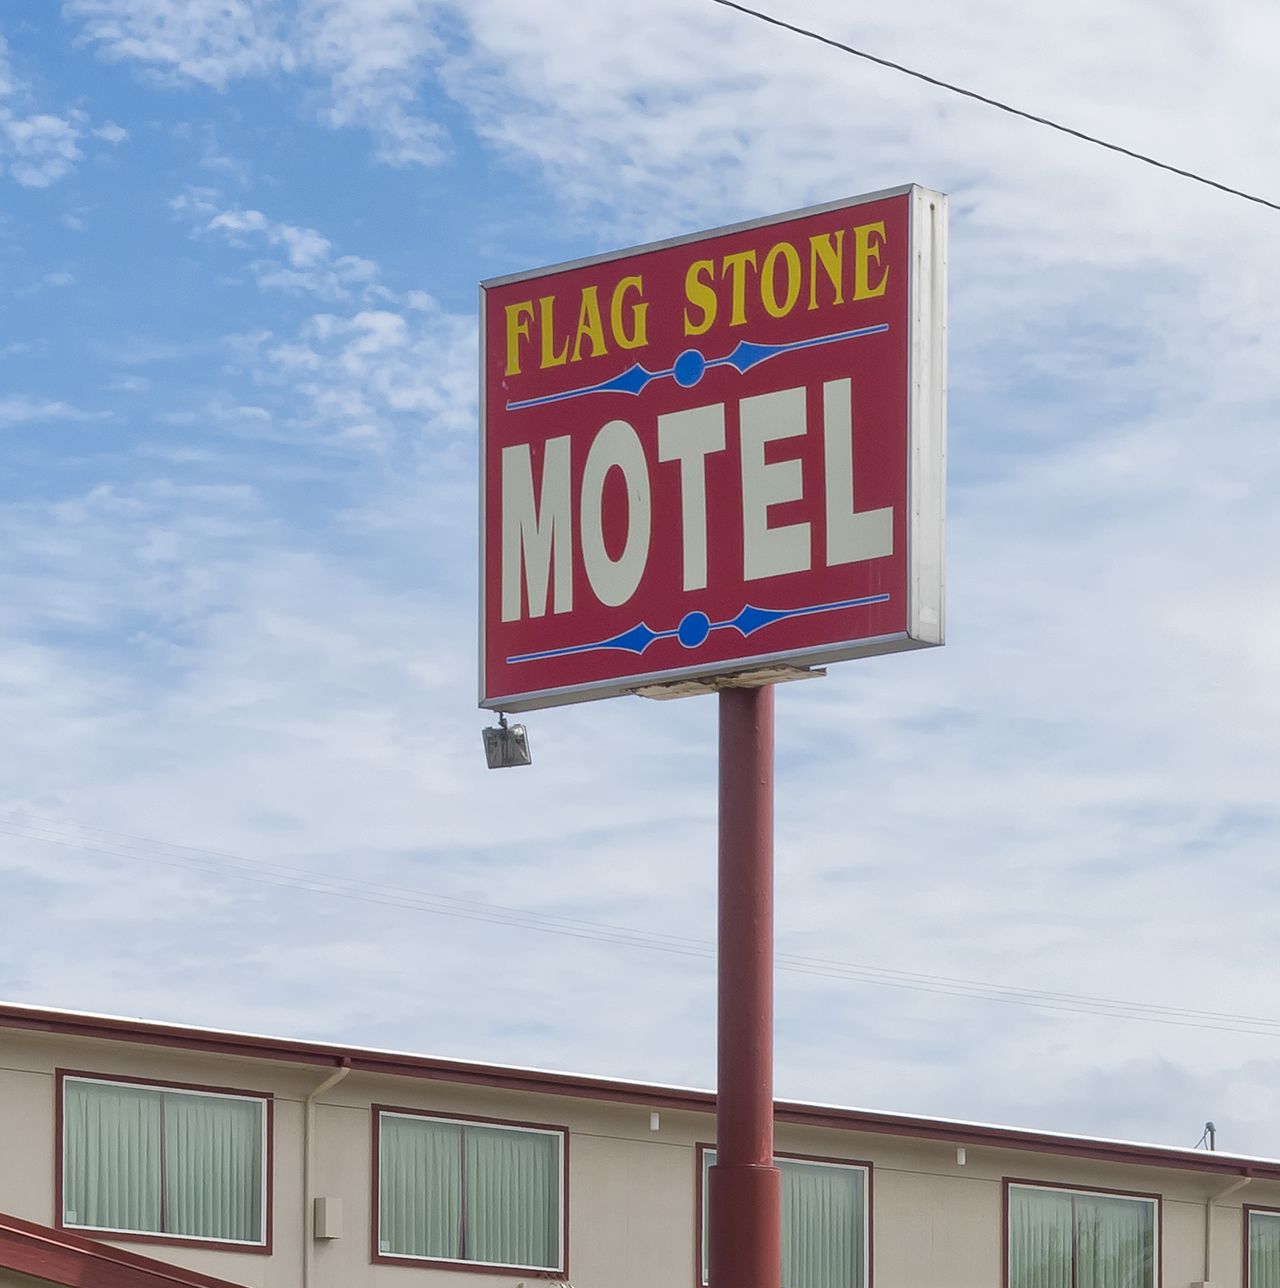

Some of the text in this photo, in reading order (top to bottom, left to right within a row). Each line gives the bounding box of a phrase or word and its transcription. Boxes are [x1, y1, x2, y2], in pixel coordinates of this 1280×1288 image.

[504, 221, 890, 376] FLAG STONE
[501, 377, 894, 623] MOTEL
